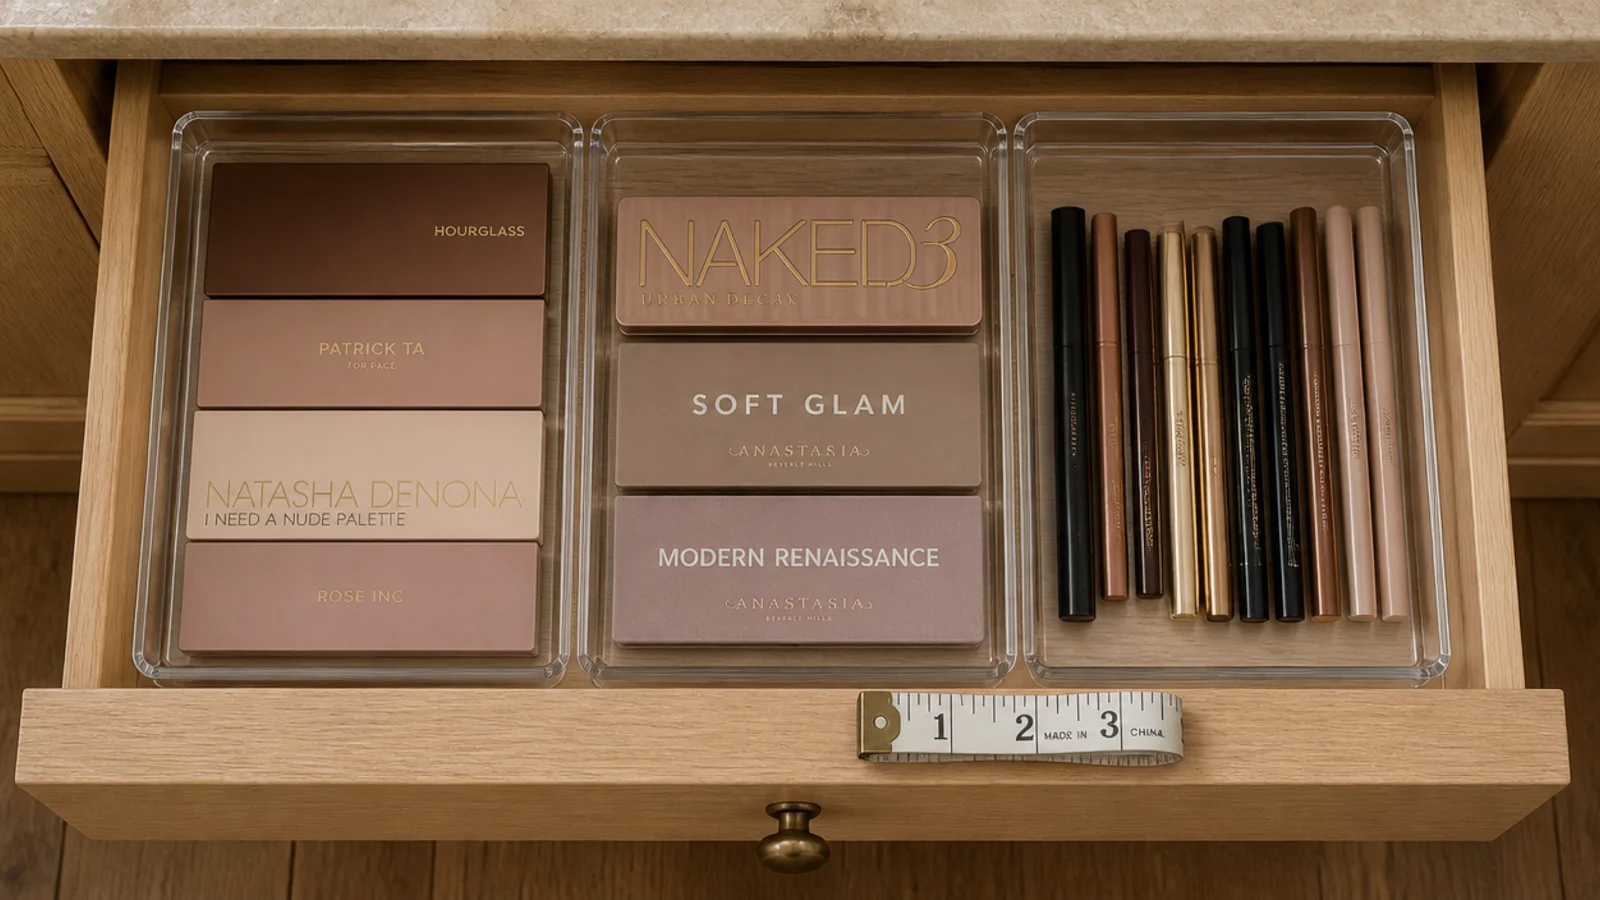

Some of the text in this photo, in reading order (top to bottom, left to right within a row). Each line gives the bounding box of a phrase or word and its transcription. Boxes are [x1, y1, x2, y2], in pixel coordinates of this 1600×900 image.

[434, 225, 525, 237] HOURGLASS
[641, 293, 716, 306] URBAN
[319, 341, 426, 356] PATRICK TA
[692, 393, 906, 416] SOFT GLAM
[727, 444, 871, 457] ANASTASIA
[206, 480, 523, 508] NATASHA DENONA
[204, 512, 406, 526] I NEED A NUDE PALETTE
[658, 547, 940, 568] MODERN RENAISSANCE
[317, 589, 404, 603] ROSE INC
[725, 597, 873, 610] ANASTASIA
[933, 713, 949, 740] 1
[1015, 714, 1035, 741] 2
[1099, 710, 1120, 739] 3
[1076, 730, 1088, 739] IN
